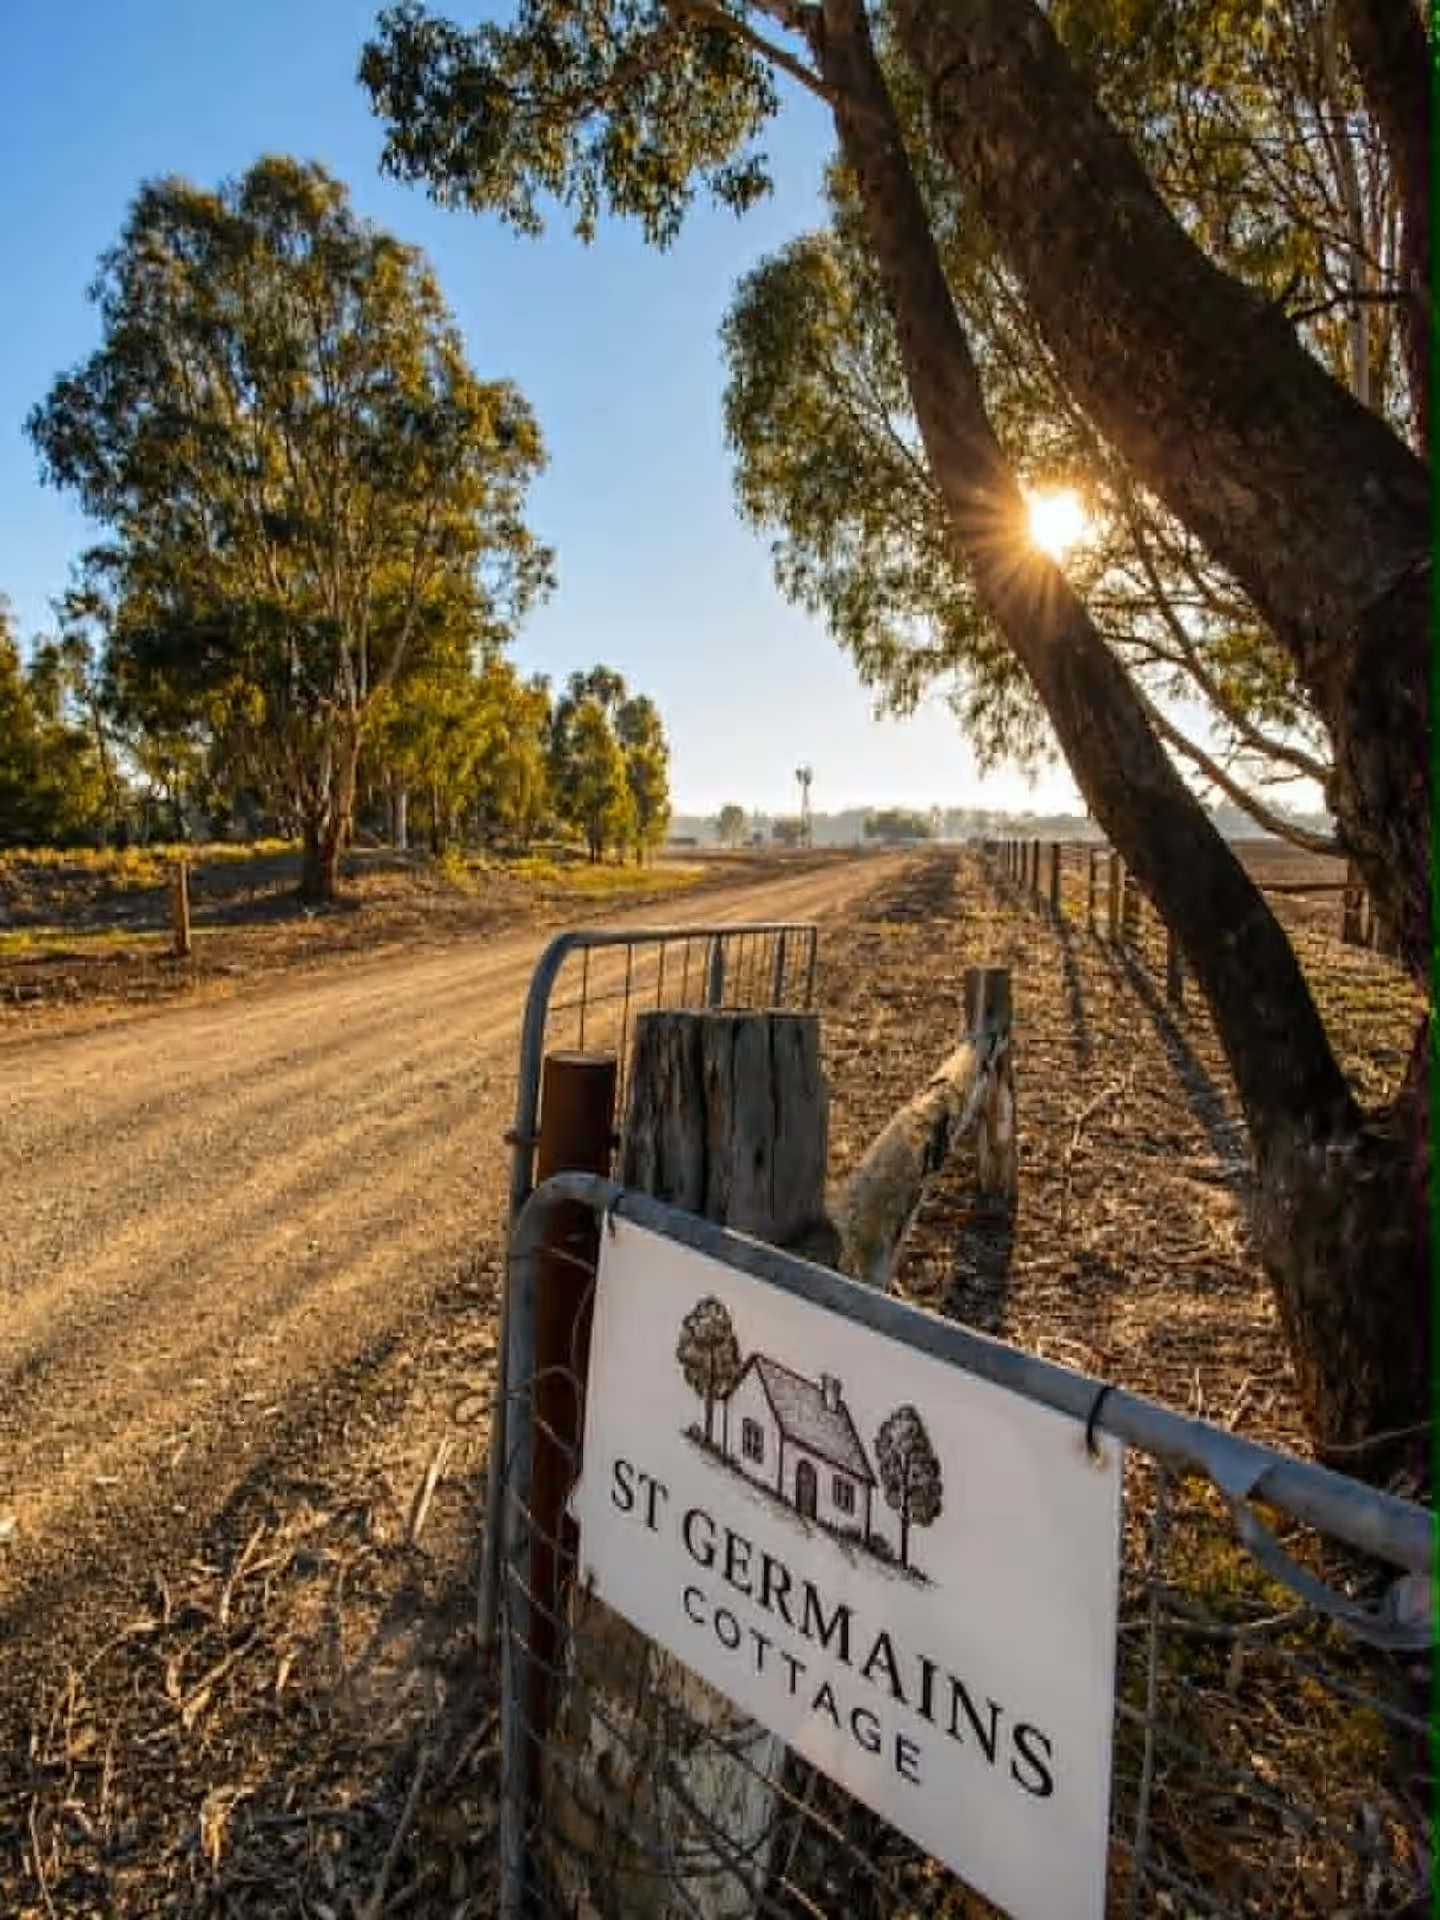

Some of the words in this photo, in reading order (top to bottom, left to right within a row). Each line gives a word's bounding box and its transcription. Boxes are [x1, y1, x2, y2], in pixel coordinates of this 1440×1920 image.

[610, 1458, 669, 1533] ST
[681, 1507, 1055, 1800] GERMAINS
[682, 1584, 922, 1787] COTTAGE
